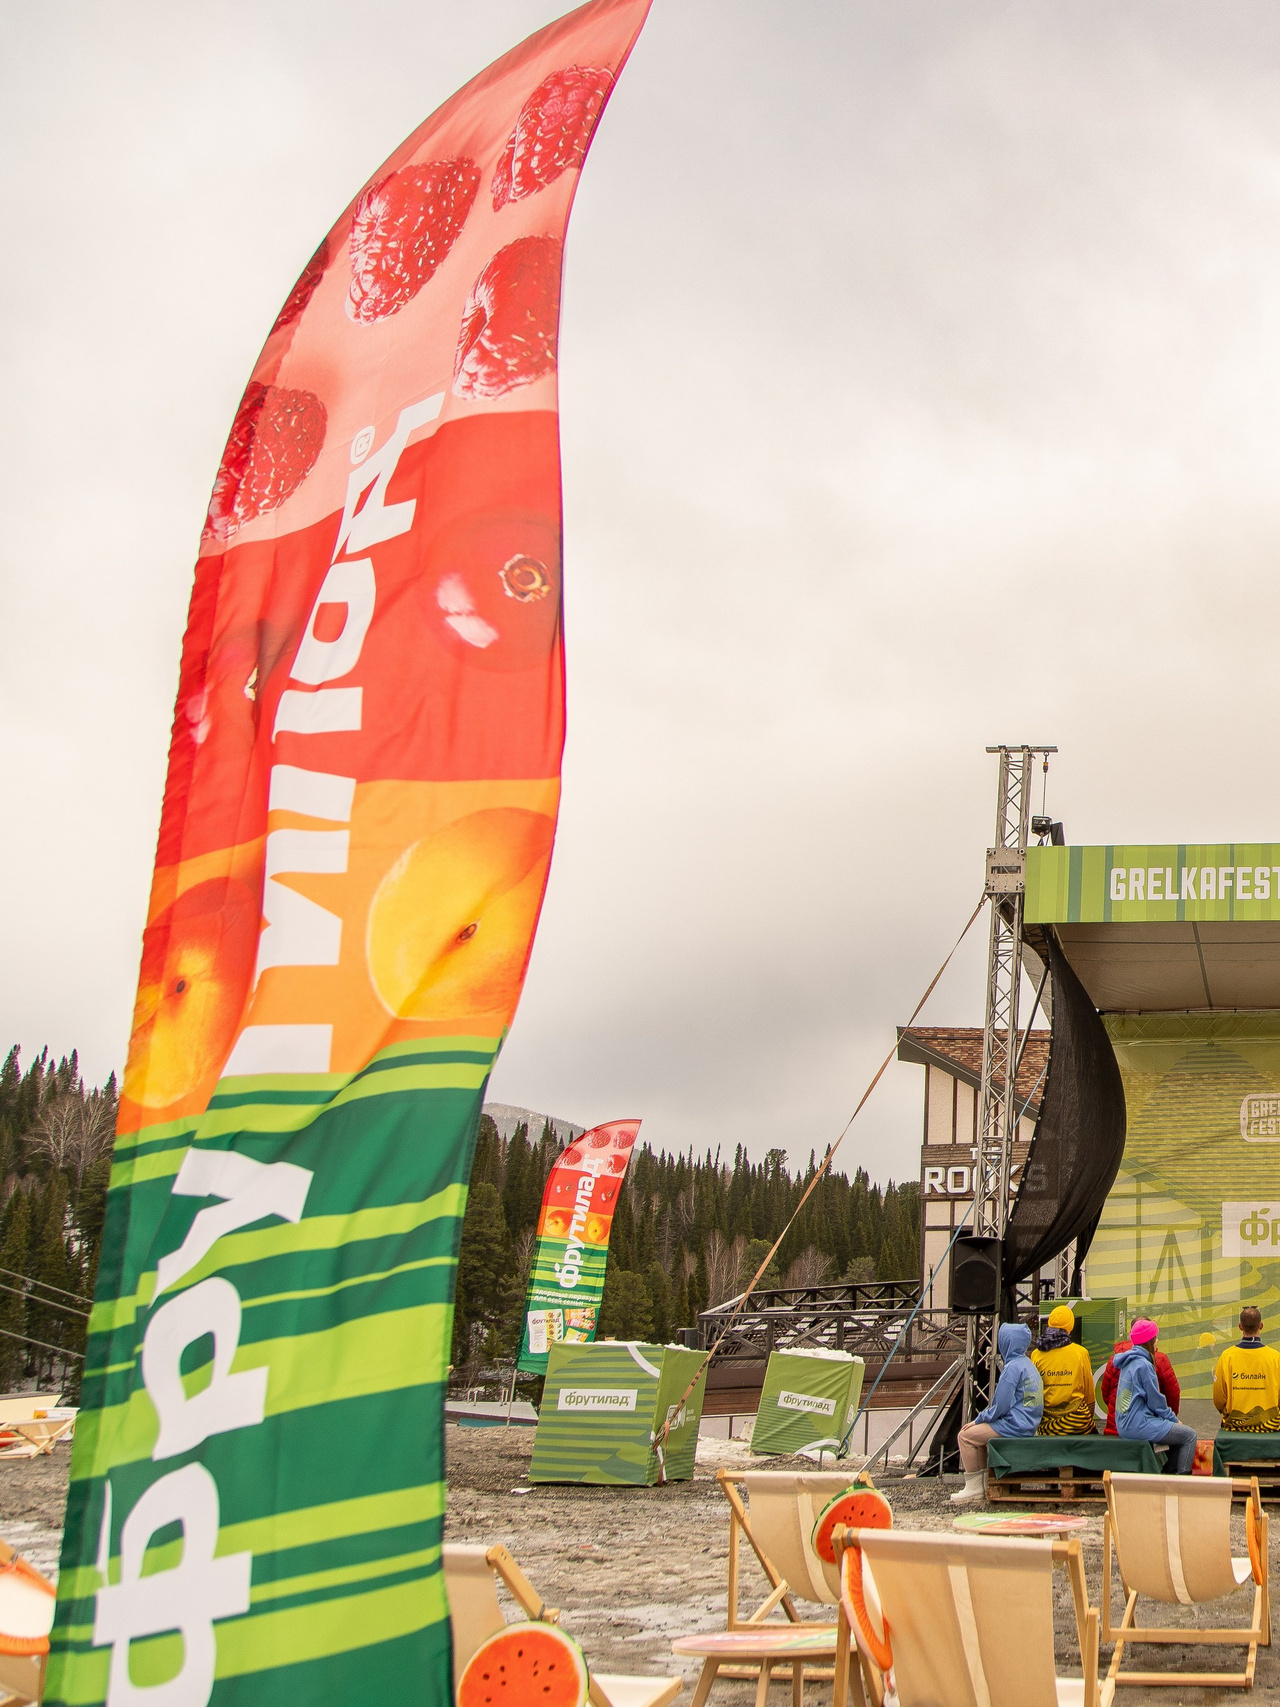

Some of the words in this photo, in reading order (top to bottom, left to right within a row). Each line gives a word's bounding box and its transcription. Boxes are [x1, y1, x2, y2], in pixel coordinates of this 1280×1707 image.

[555, 1155, 604, 1289] фрутилад
[565, 1391, 630, 1406] фрутилад
[783, 1394, 831, 1411] фрутилад
